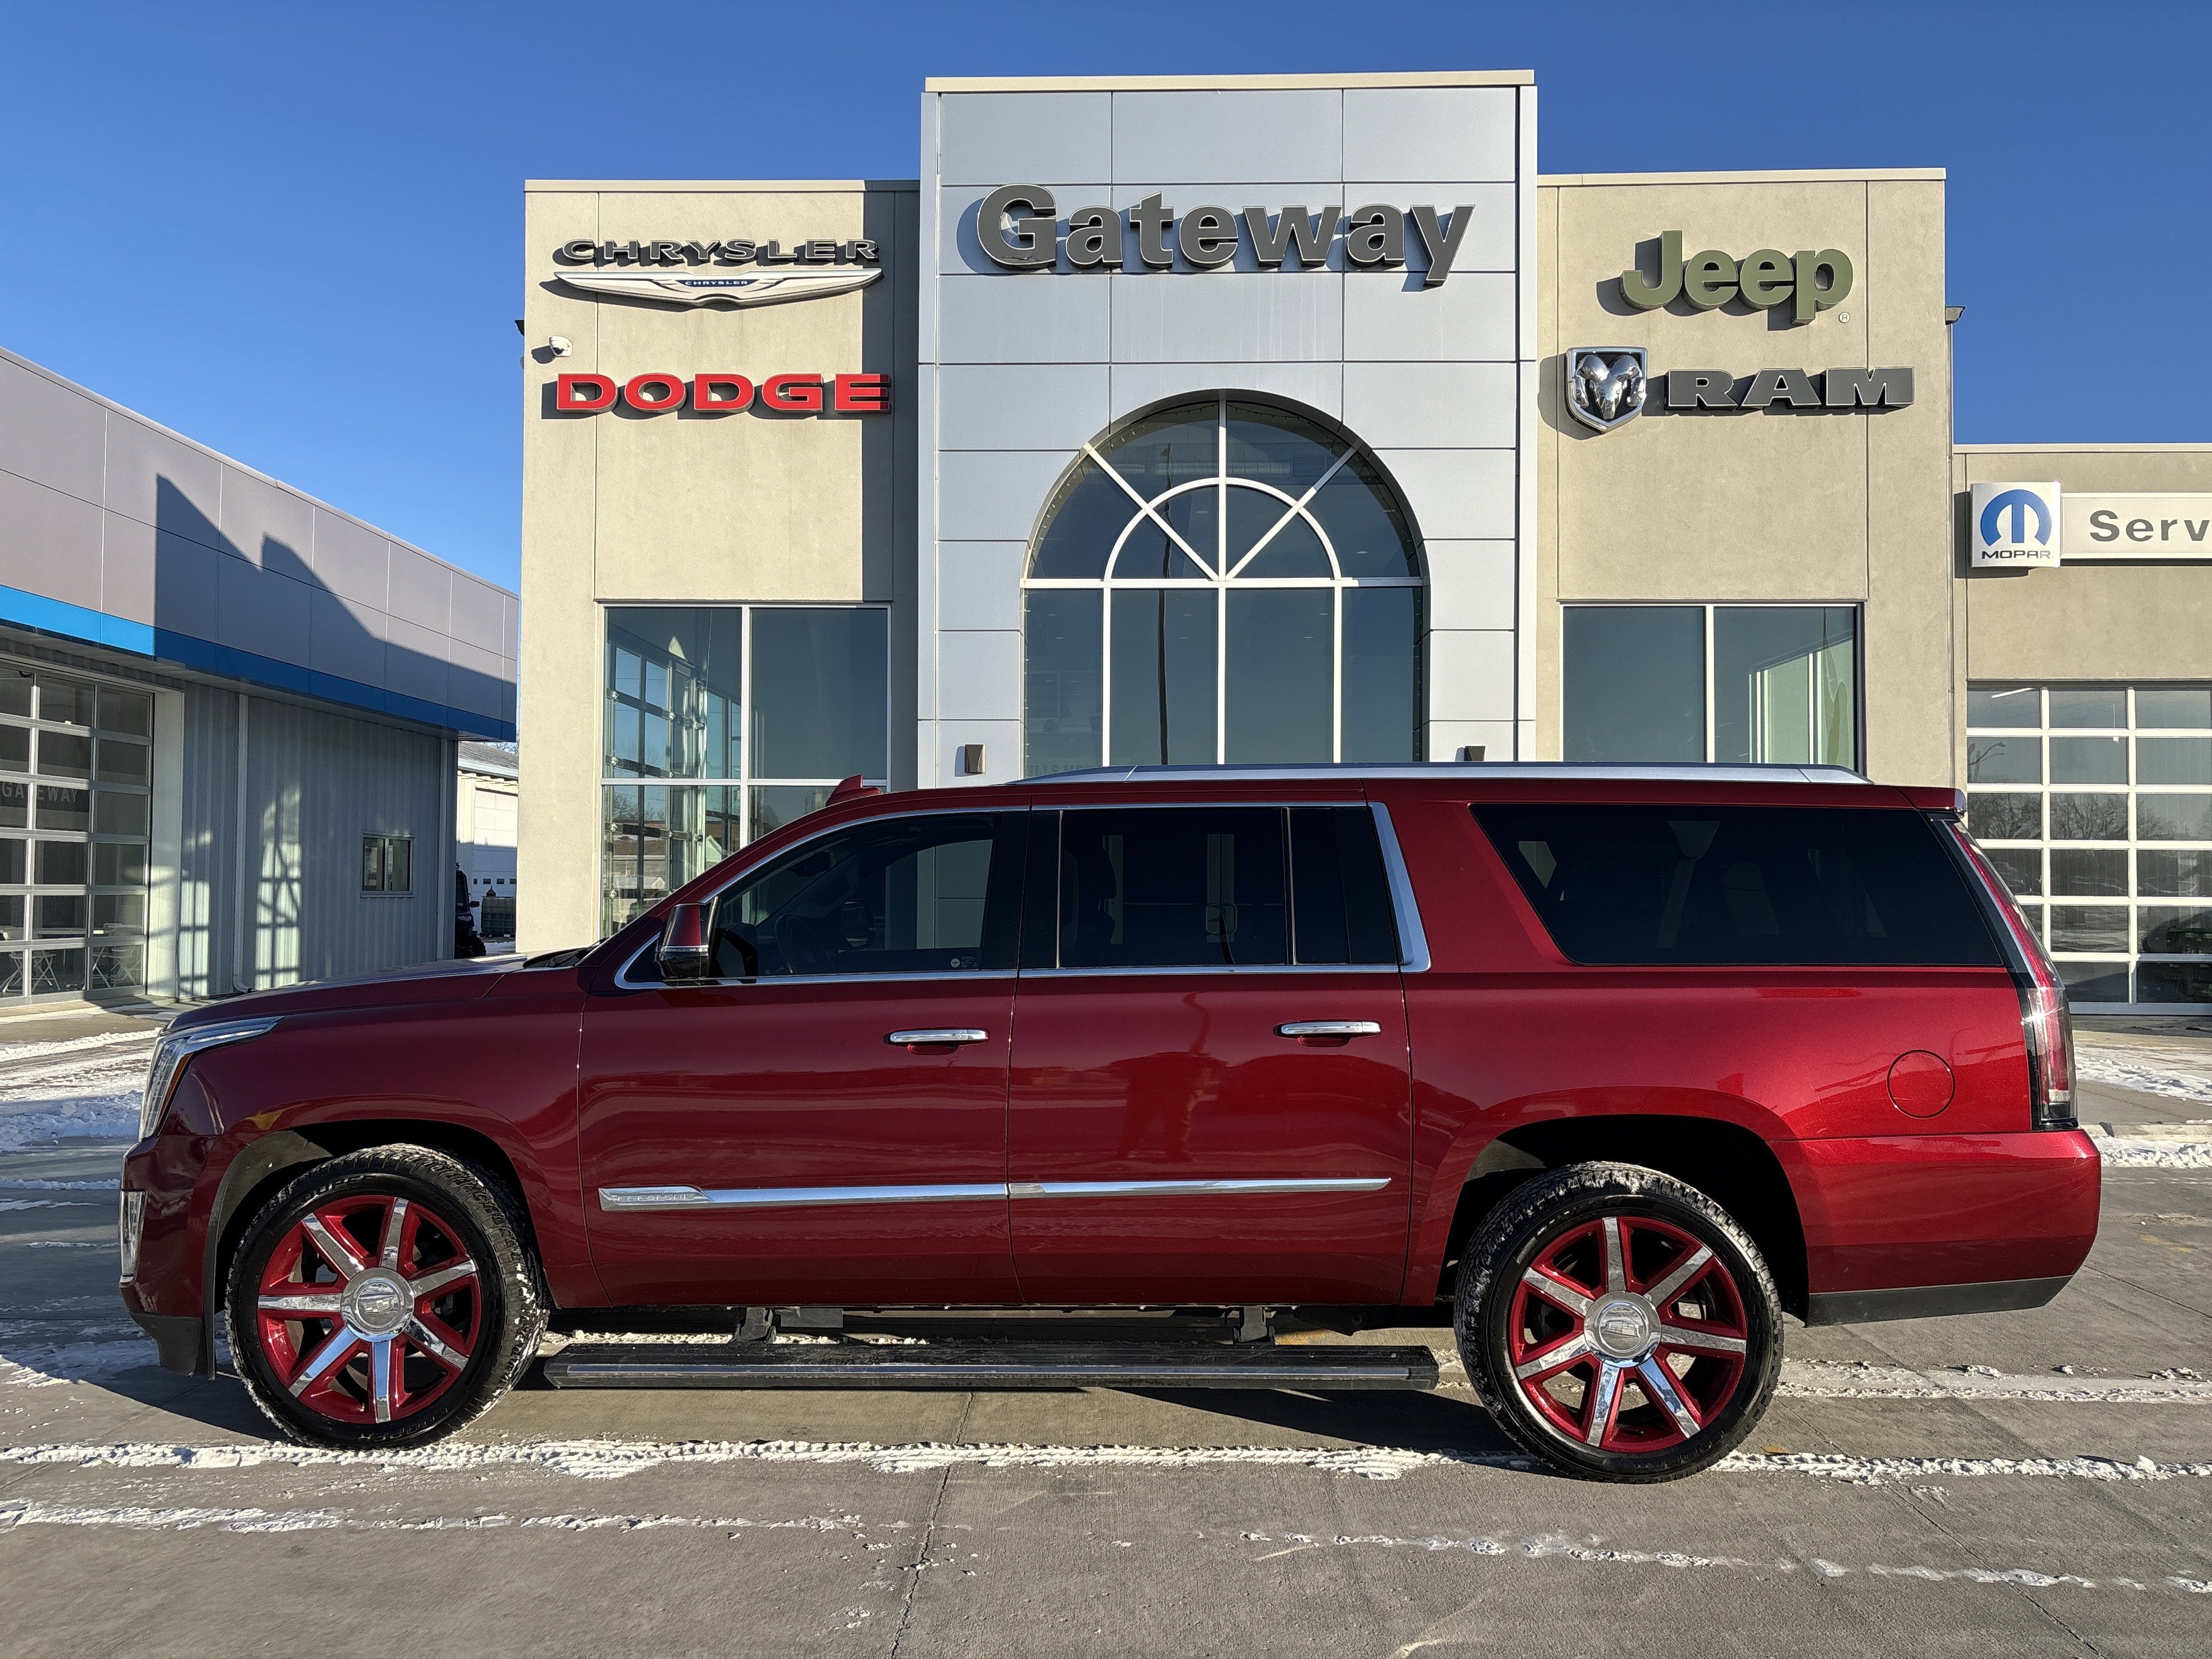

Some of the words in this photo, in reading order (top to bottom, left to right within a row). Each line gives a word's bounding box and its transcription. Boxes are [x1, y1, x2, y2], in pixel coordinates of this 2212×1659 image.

[562, 239, 879, 262] CHRYSLER
[977, 183, 1475, 287] Gateway
[1620, 230, 1853, 324] Jeep
[557, 373, 891, 413] DODGE
[1664, 366, 1915, 410] RAM
[2090, 510, 2210, 542] Serv
[1982, 550, 2051, 559] MOPAR
[2, 782, 77, 803] GAEWAY
